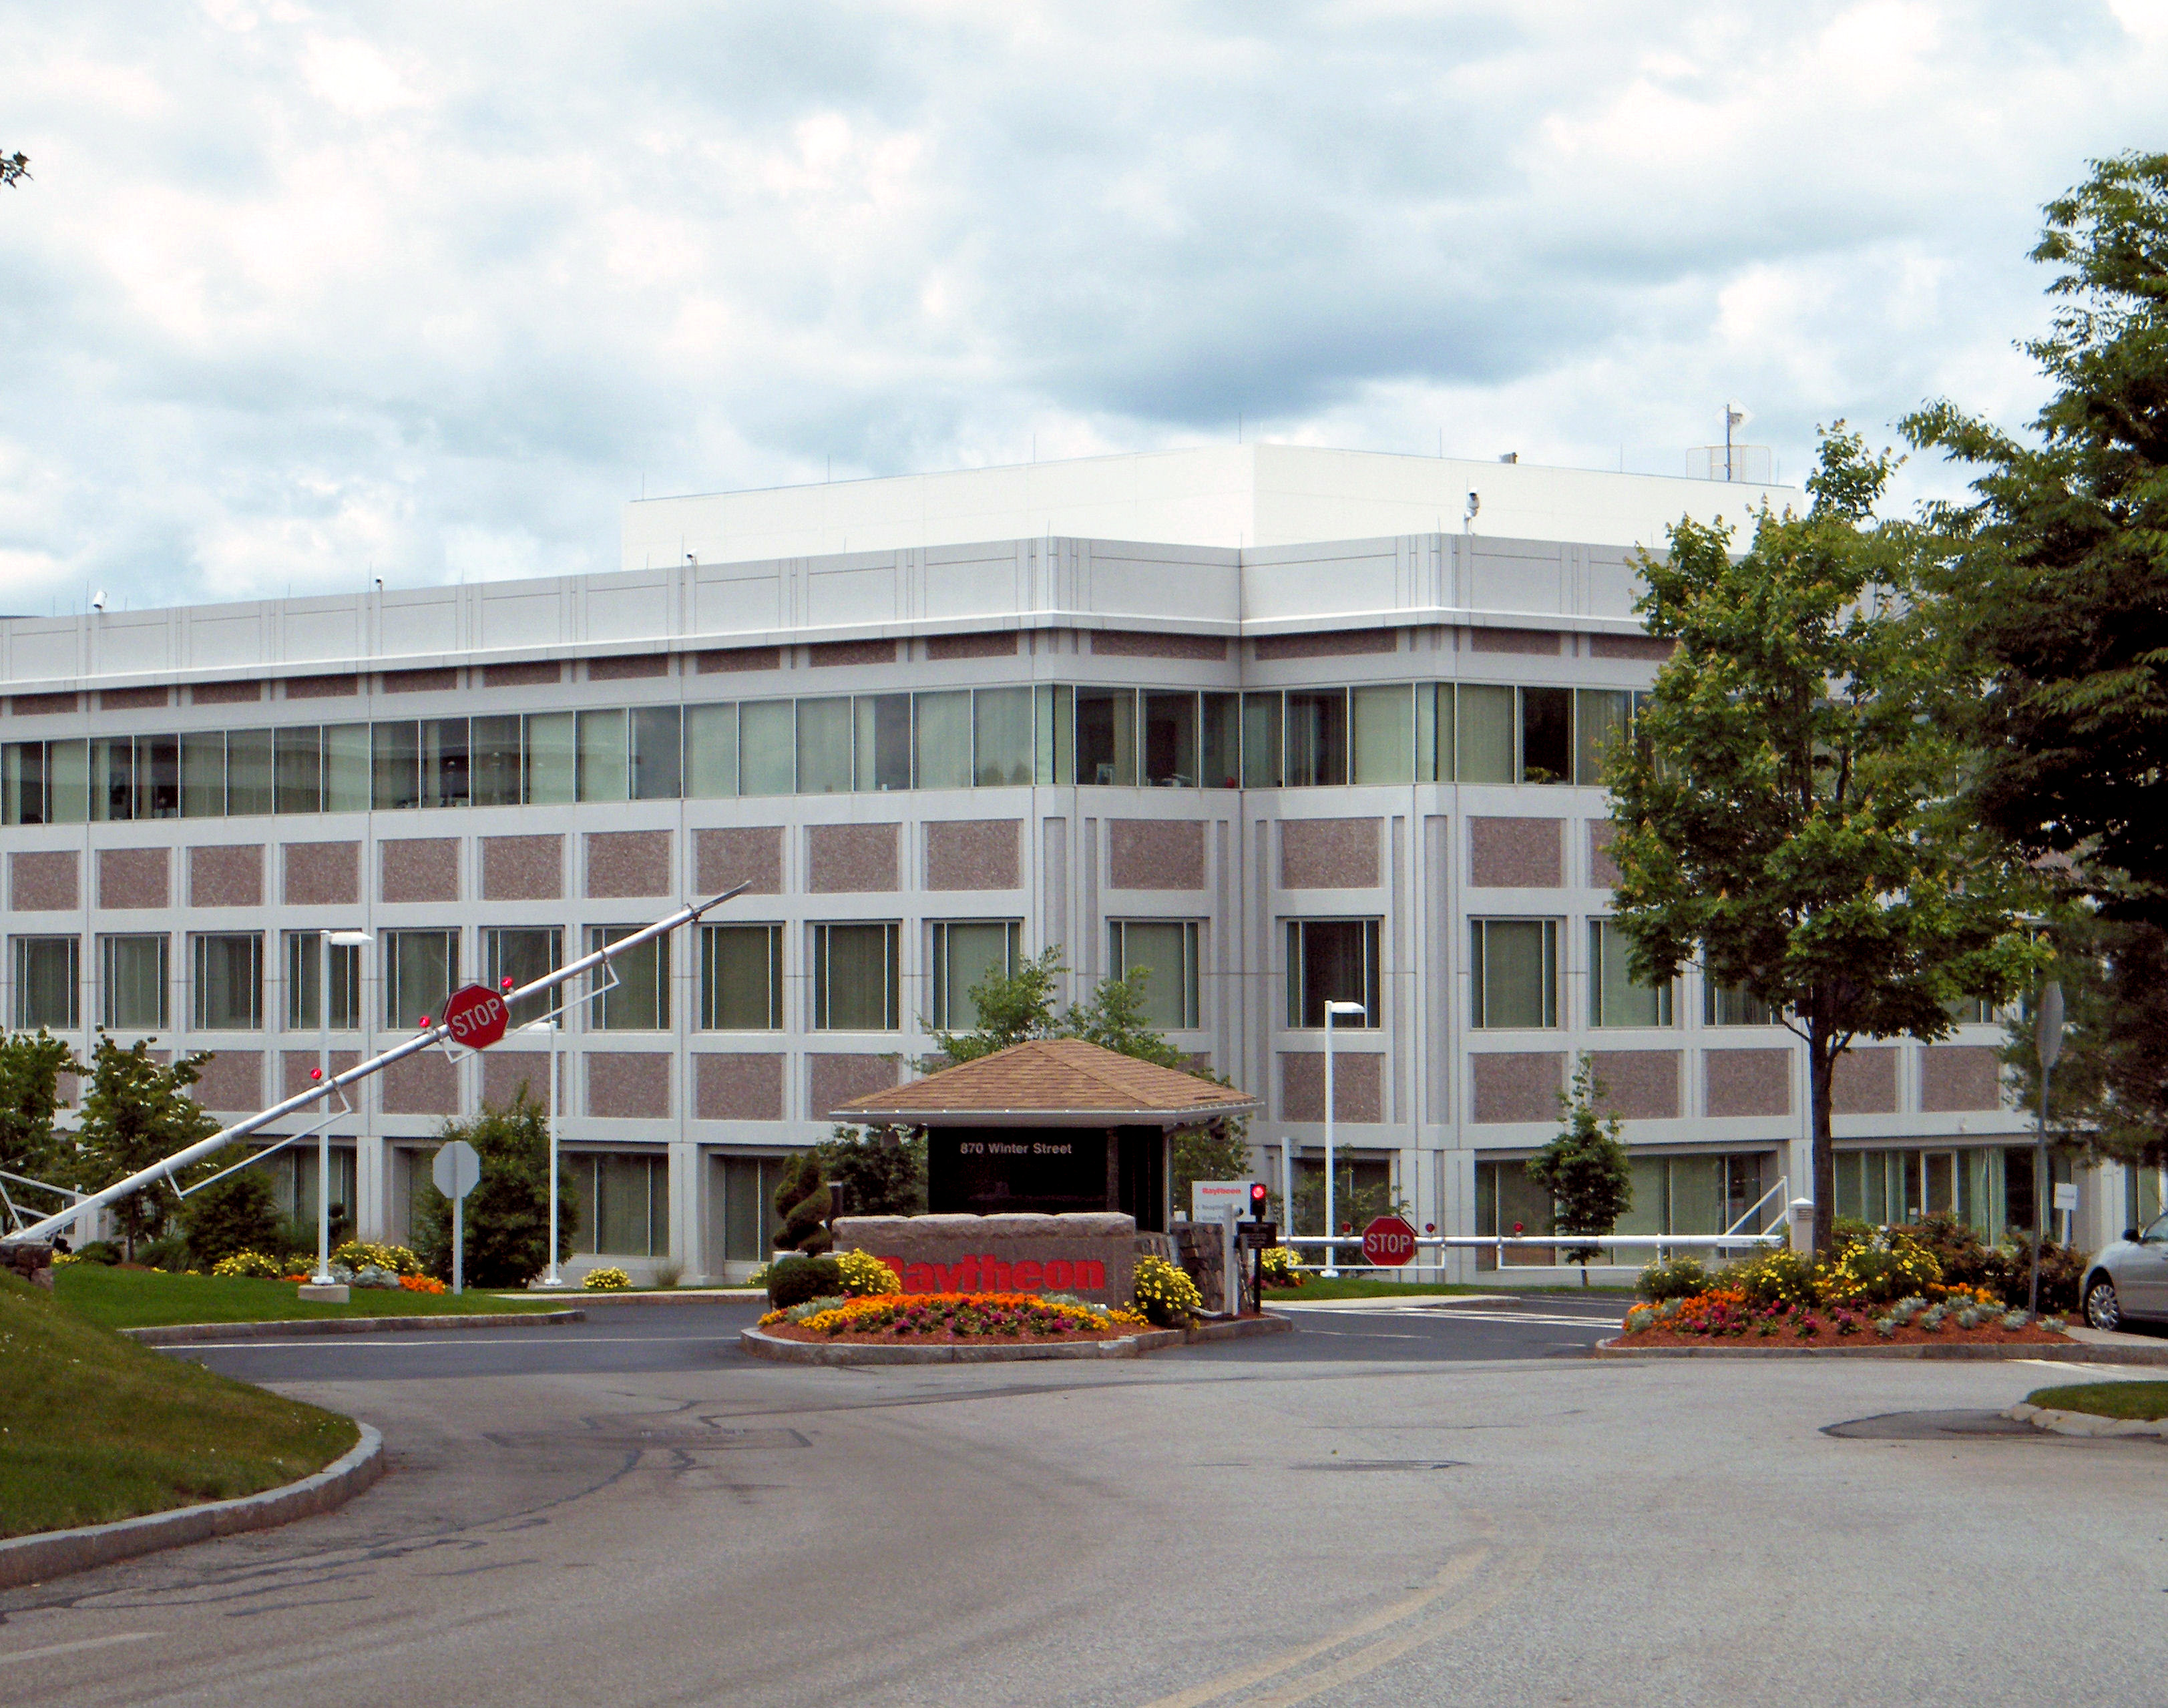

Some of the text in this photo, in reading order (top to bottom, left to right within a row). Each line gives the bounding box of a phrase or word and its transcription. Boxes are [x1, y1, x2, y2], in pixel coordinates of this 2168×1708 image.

[452, 998, 500, 1037] STOP
[960, 1142, 1072, 1154] 870 Winter Street
[1367, 1233, 1410, 1253] STOP
